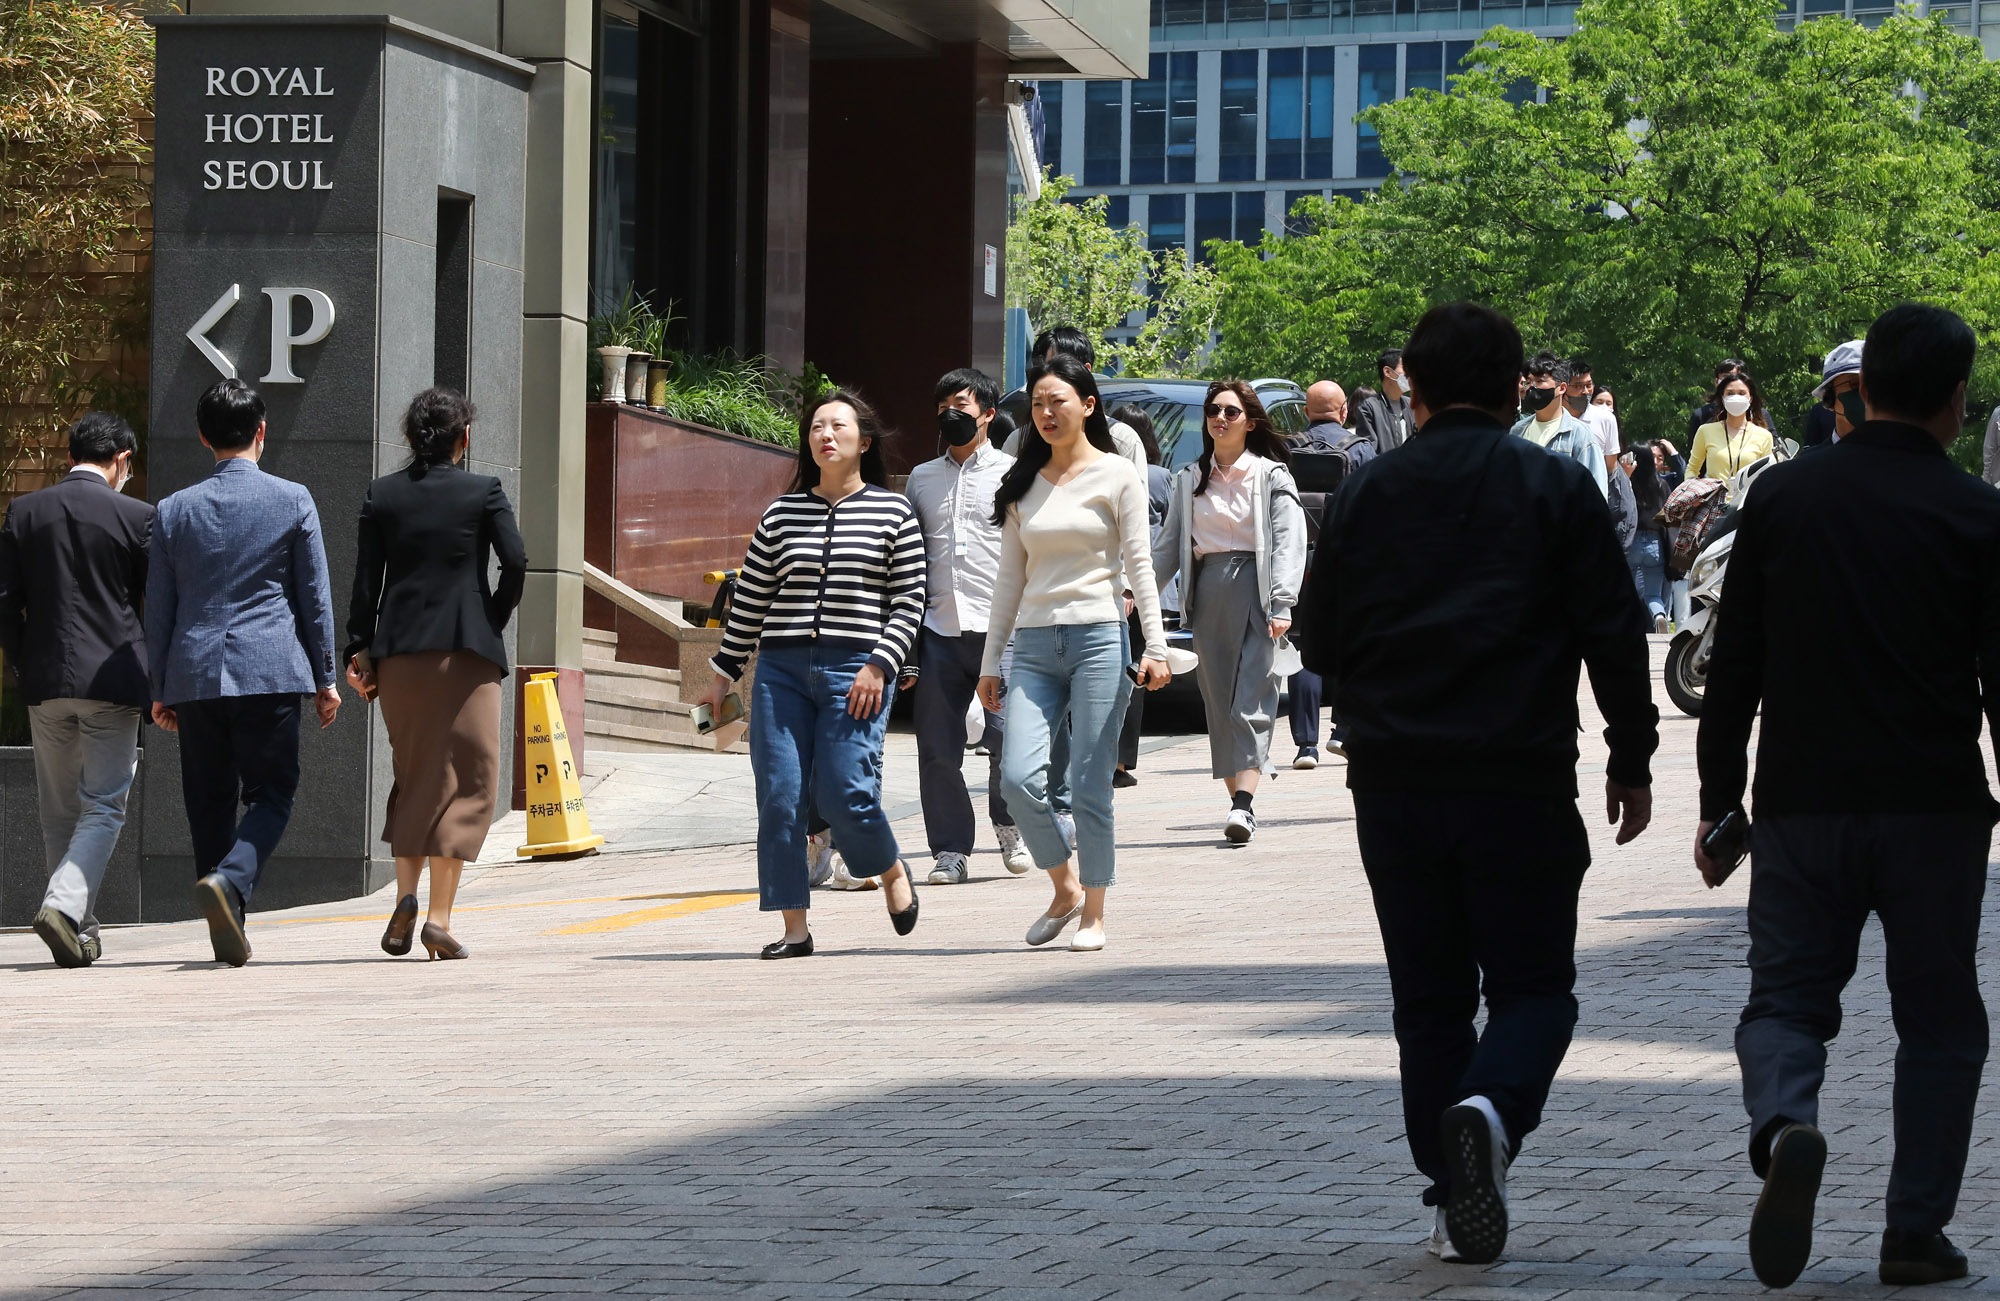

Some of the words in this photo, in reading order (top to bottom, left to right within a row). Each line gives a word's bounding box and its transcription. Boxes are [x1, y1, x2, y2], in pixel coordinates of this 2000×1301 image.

[205, 67, 335, 97] ROYAL
[204, 114, 334, 144] HOTEL
[203, 160, 334, 190] SEOUL
[259, 287, 336, 384] P
[527, 734, 550, 745] PARKING
[533, 725, 541, 733] NO
[530, 802, 562, 818] 주차금지
[565, 798, 584, 814] 주차금지
